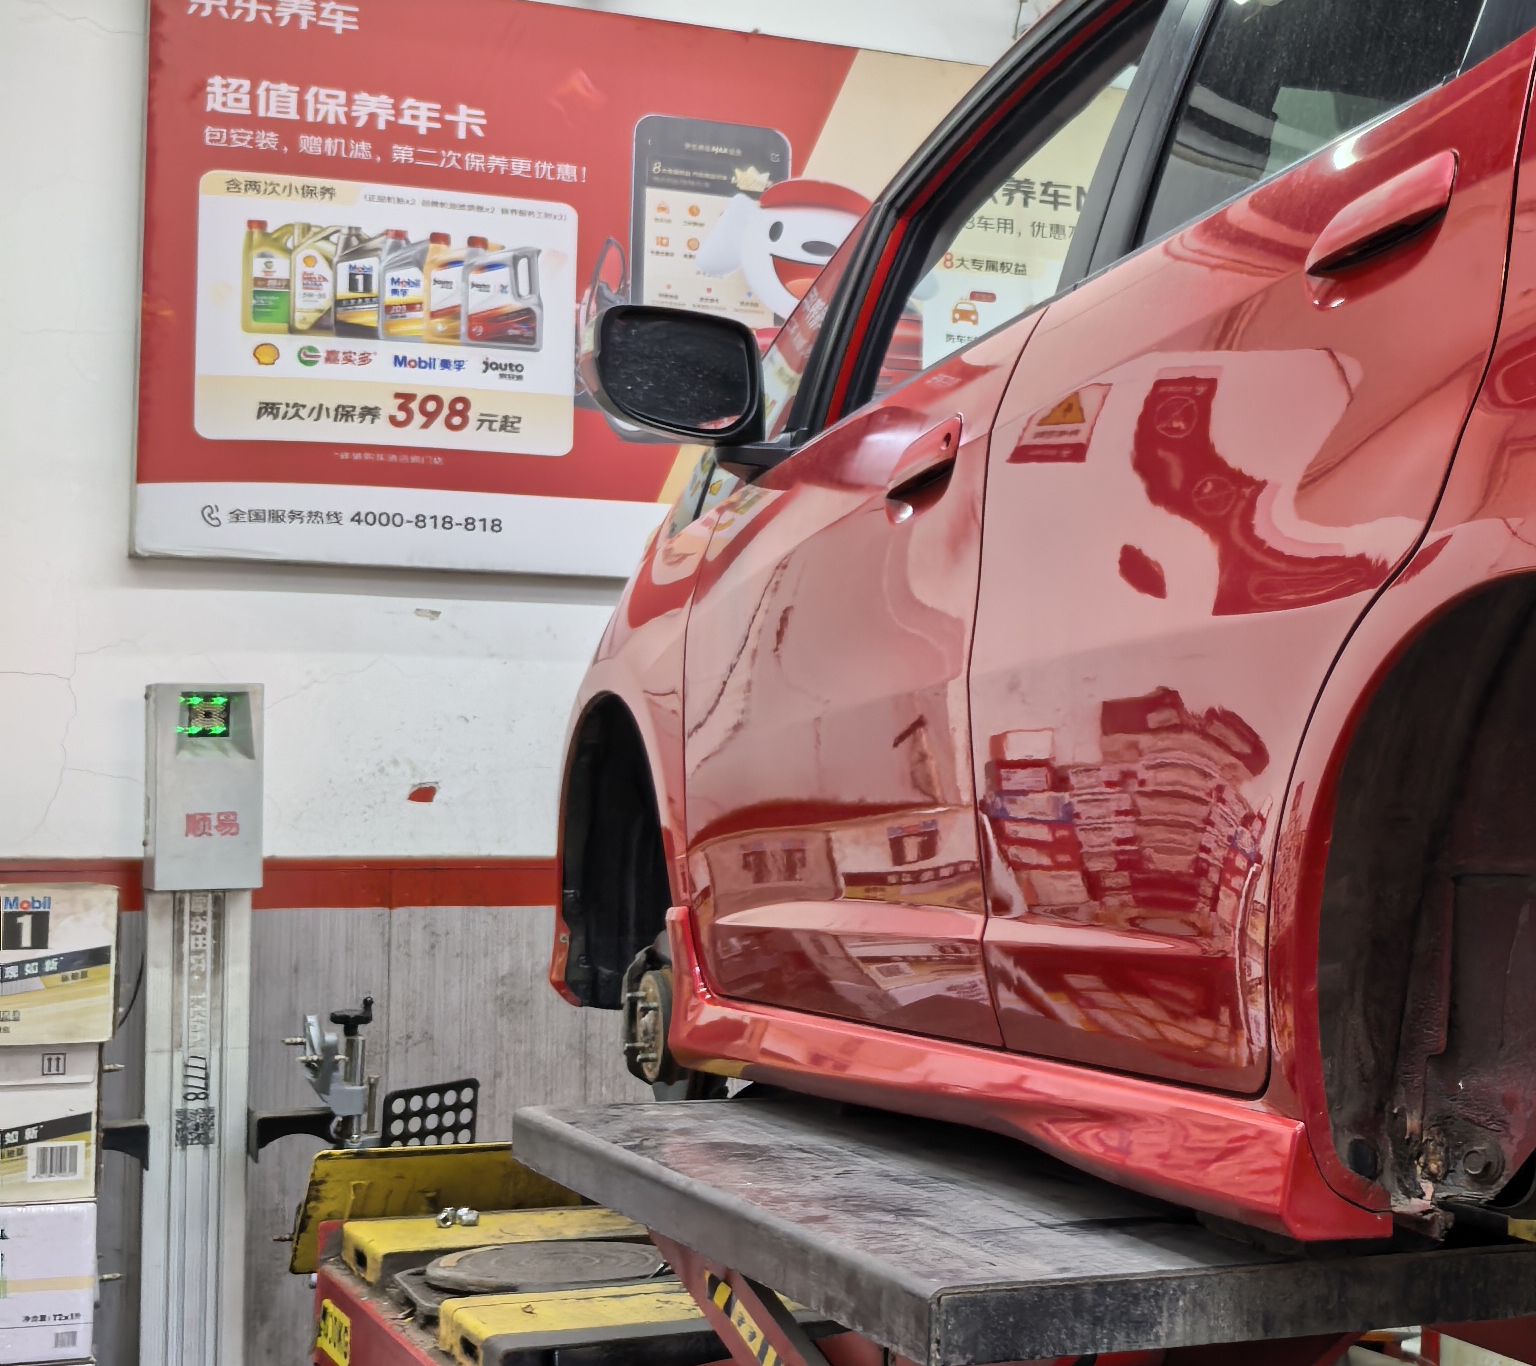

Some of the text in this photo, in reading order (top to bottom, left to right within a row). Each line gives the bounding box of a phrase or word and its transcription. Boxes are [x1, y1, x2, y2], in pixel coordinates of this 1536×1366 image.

[205, 75, 488, 140] 超值保养年卡
[225, 178, 337, 202] 含两次小保养
[991, 177, 1090, 213] 养车
[942, 251, 1028, 276] 8大专属权益
[393, 354, 437, 371] Mobil
[482, 357, 525, 374] jauto
[256, 392, 523, 434] 两次小保养 398 元起
[228, 508, 503, 534] 全国服务热线 4000-818-818
[3, 895, 52, 911] Mobil
[16, 914, 33, 948] 1
